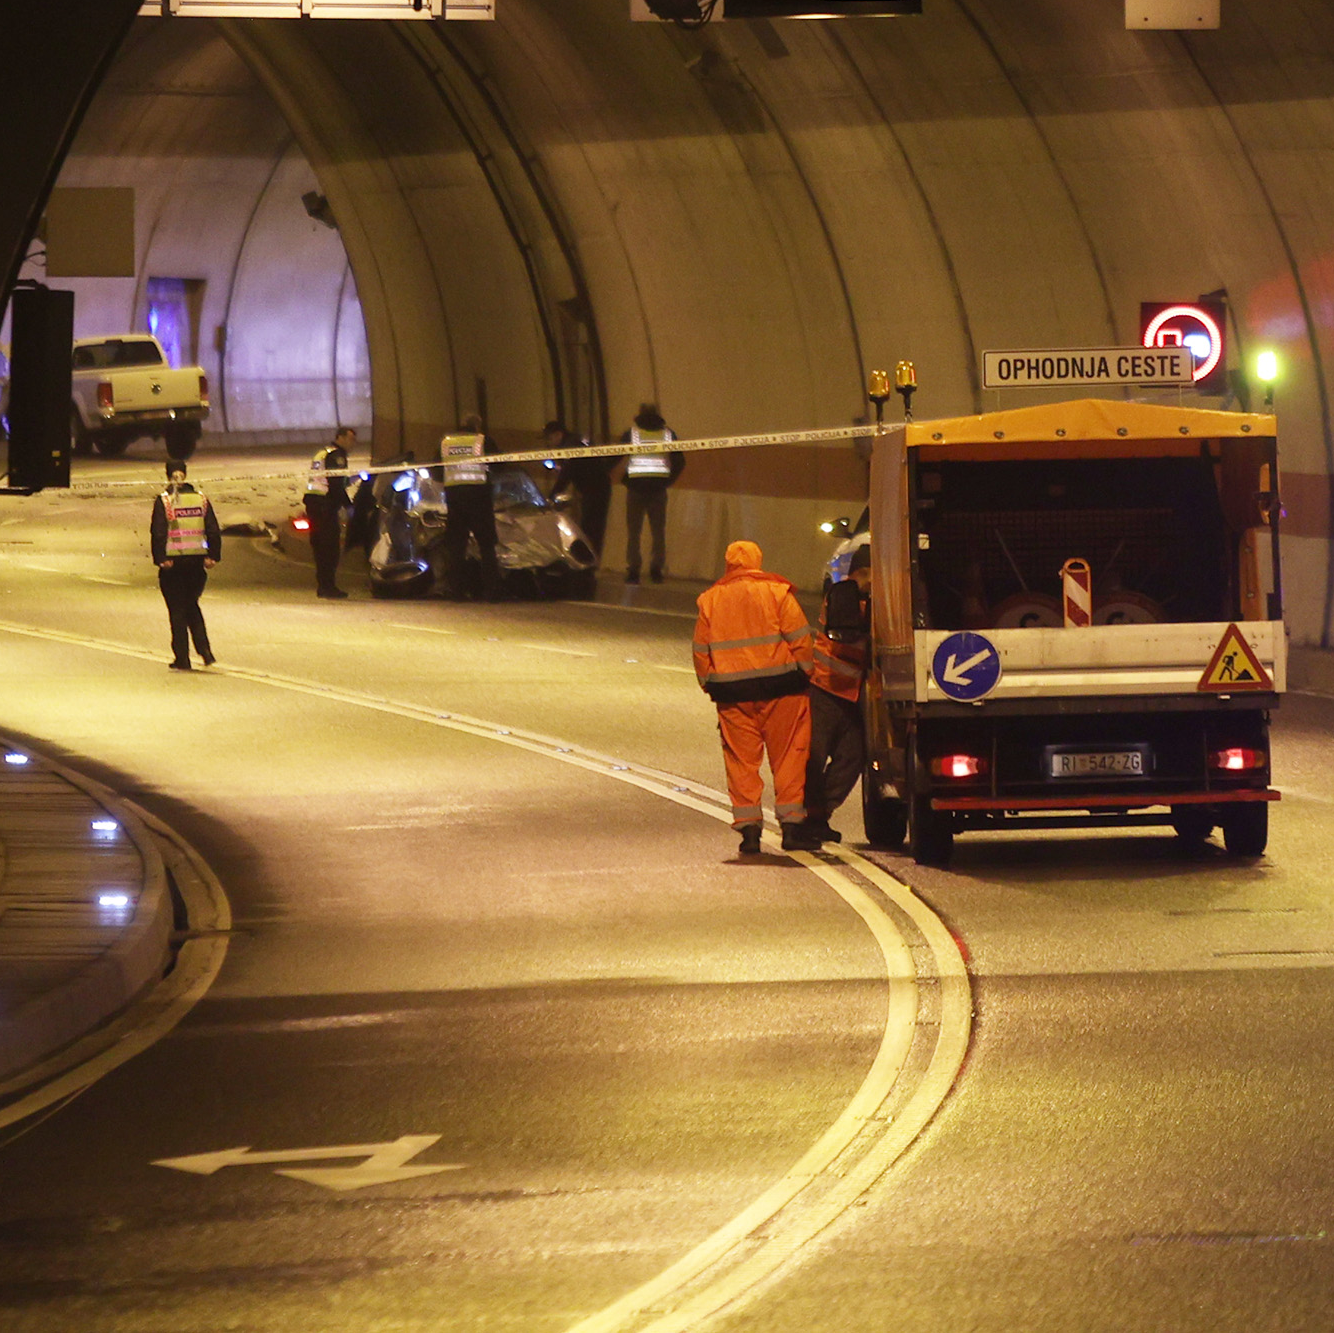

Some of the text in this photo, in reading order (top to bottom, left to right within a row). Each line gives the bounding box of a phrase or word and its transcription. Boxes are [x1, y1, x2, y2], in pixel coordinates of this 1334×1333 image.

[998, 355, 1181, 381] OPHODNJA CESTE
[1062, 756, 1076, 771] RI
